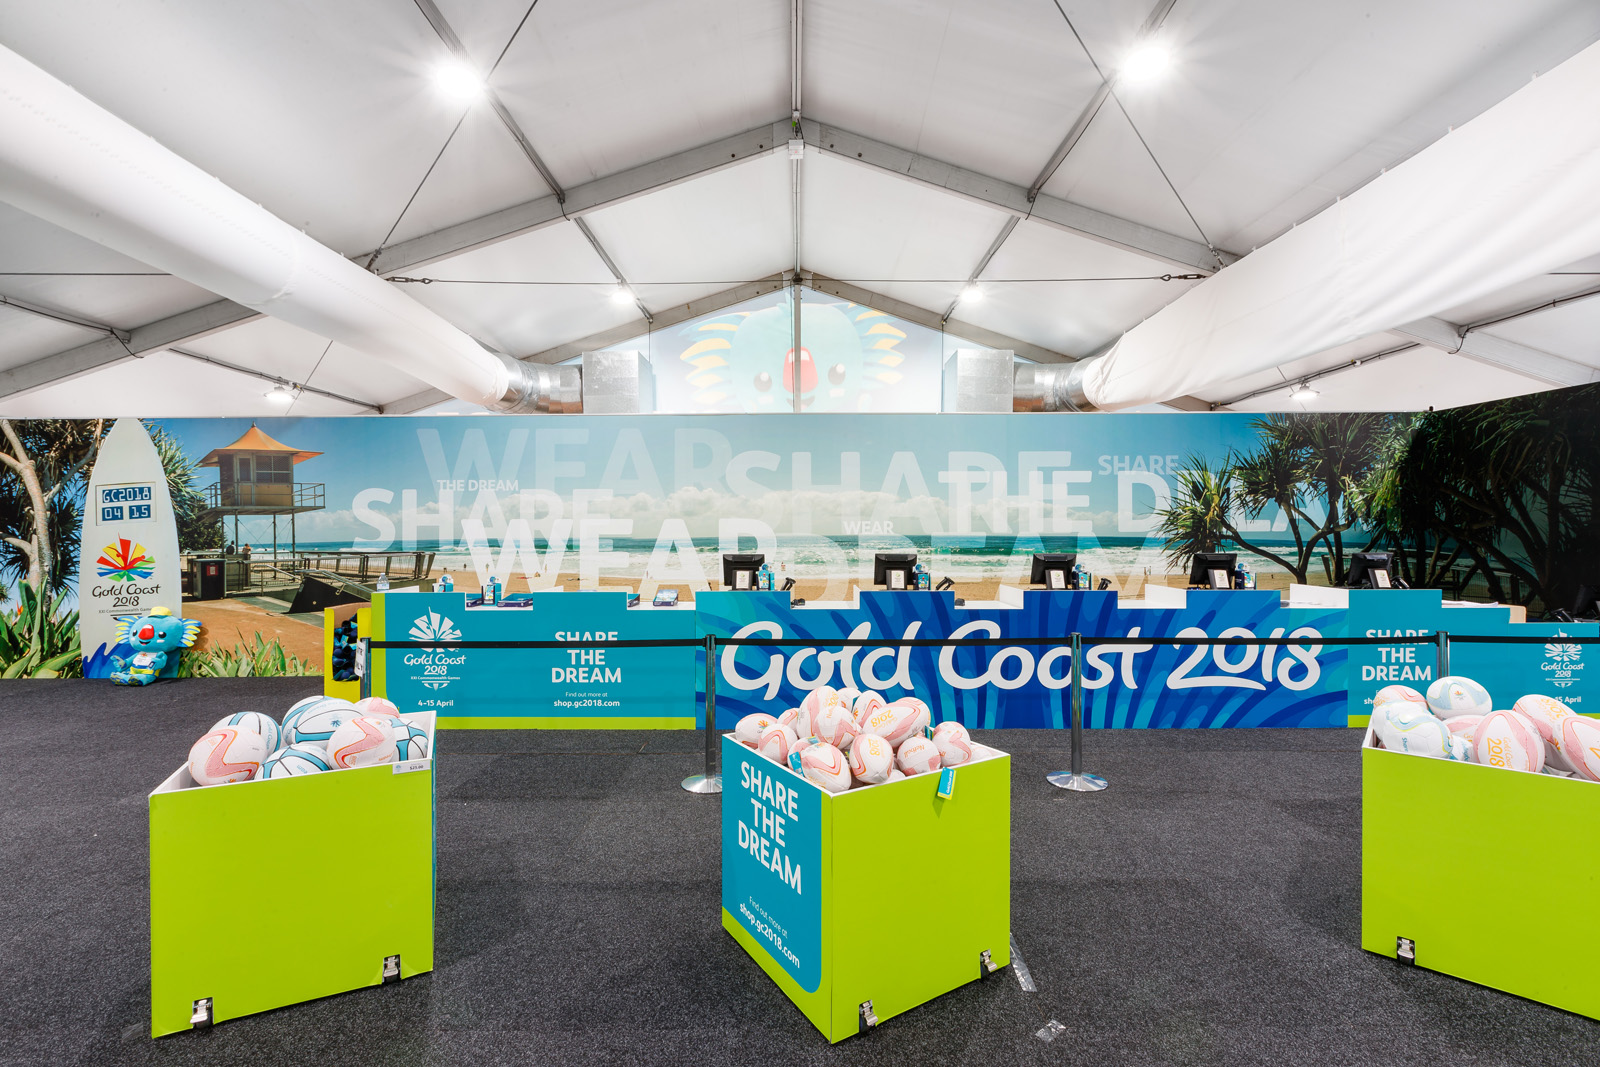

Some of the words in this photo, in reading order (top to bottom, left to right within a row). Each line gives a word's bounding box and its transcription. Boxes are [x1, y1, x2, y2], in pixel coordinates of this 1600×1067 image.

[1098, 455, 1179, 475] SHARE
[436, 479, 468, 491] THE
[468, 479, 519, 491] DREAM
[725, 450, 1073, 534] SHARE
[103, 487, 150, 503] GC2018
[938, 470, 1092, 533] THE
[104, 507, 121, 519] 04
[131, 505, 149, 518] 15
[352, 487, 614, 553] SHARE
[842, 520, 895, 535] WEAR
[91, 584, 124, 598] Gold
[126, 583, 161, 595] Coast
[112, 596, 140, 607] 2018
[403, 653, 434, 666] Gold
[435, 653, 467, 665] Coast
[566, 649, 606, 665] THE
[720, 620, 923, 700] Gold
[938, 619, 1153, 690] Coast
[1166, 626, 1324, 691] 2018
[1377, 647, 1416, 663] THE
[424, 665, 448, 675] 2018
[1361, 665, 1432, 681] DREAM
[1541, 662, 1562, 671] Gold
[1562, 662, 1585, 670] Coast
[551, 667, 622, 683] DREAM
[436, 699, 454, 709] April
[553, 699, 620, 709] shop.gc2018.com
[1564, 696, 1582, 704] April
[1486, 737, 1505, 767] 2018
[741, 761, 799, 822] SHARE
[751, 797, 786, 848] THE
[738, 820, 802, 895] DREAM
[760, 908, 768, 920] out
[768, 916, 781, 932] more
[782, 929, 788, 939] at
[740, 903, 800, 968] shop.gc2018.com
